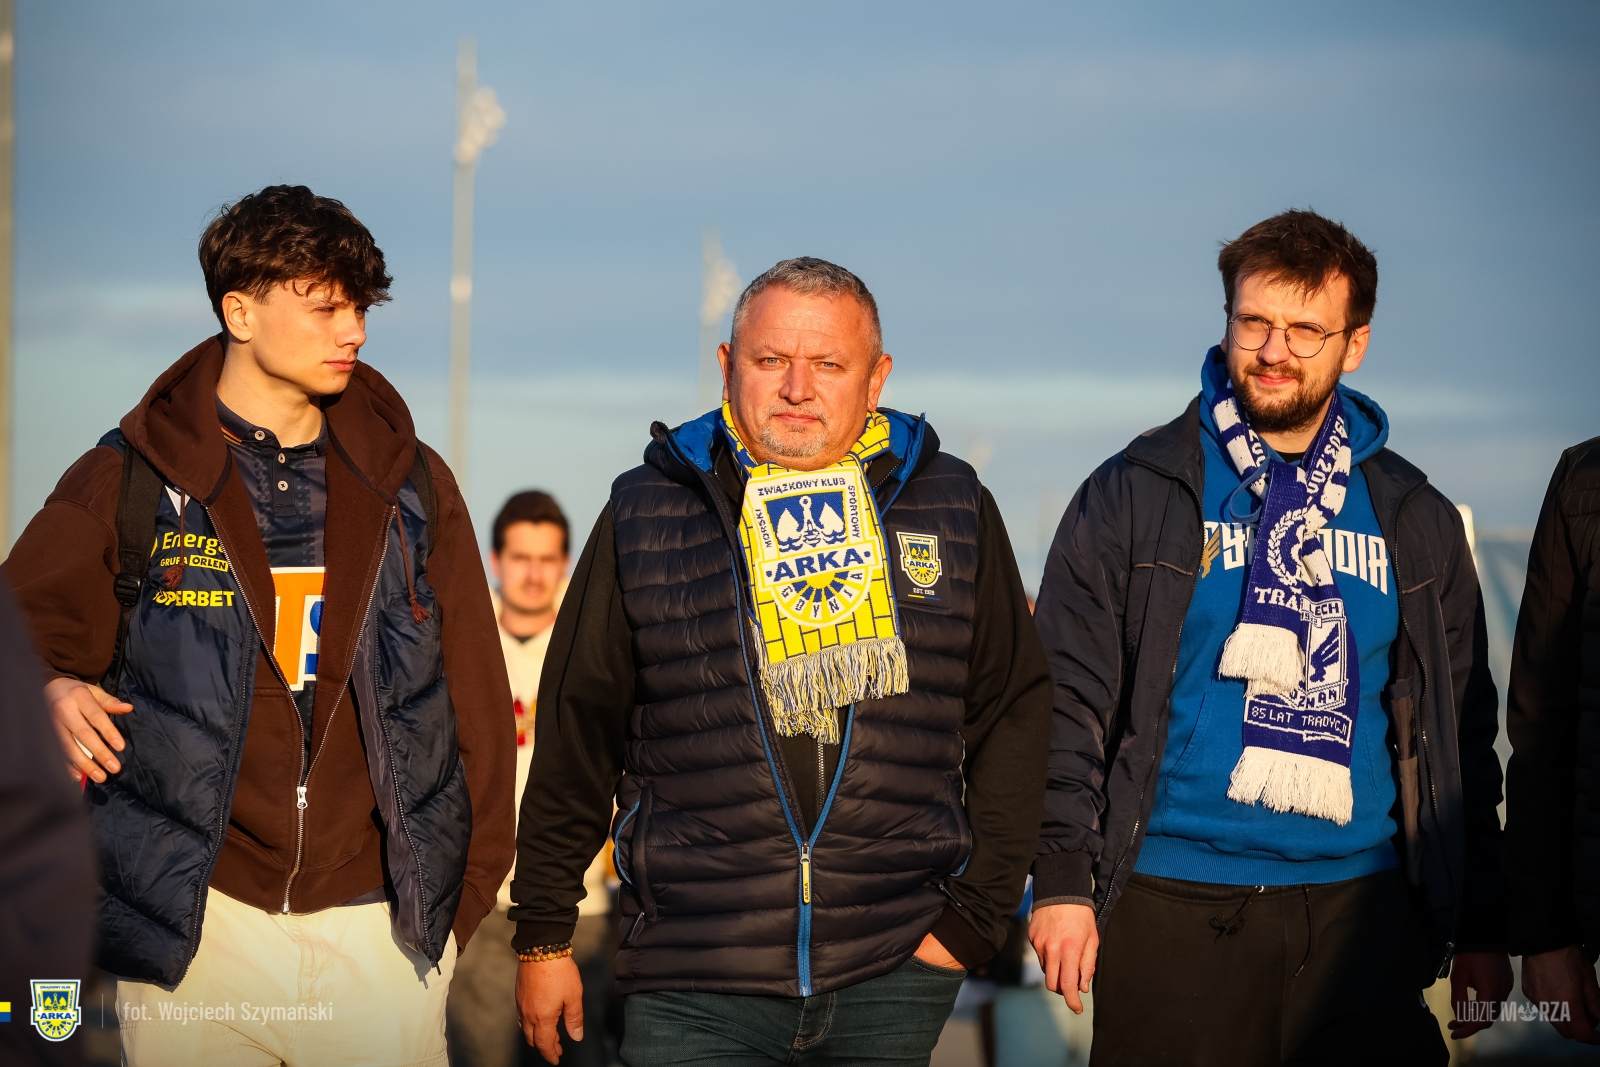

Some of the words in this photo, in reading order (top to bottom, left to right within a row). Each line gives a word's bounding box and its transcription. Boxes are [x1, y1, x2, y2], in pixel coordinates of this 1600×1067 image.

[821, 477, 846, 487] KLUB
[848, 485, 861, 538] SPORTOWY
[755, 508, 773, 548] MORSKI
[160, 556, 188, 567] GRUPA
[192, 556, 227, 570] ORLEN
[773, 548, 864, 583] ARKA
[909, 560, 935, 569] ARKA
[780, 571, 863, 618] GDYNIA
[1254, 586, 1302, 613] TRA
[1251, 706, 1267, 719] 85
[1269, 709, 1295, 723] LAT
